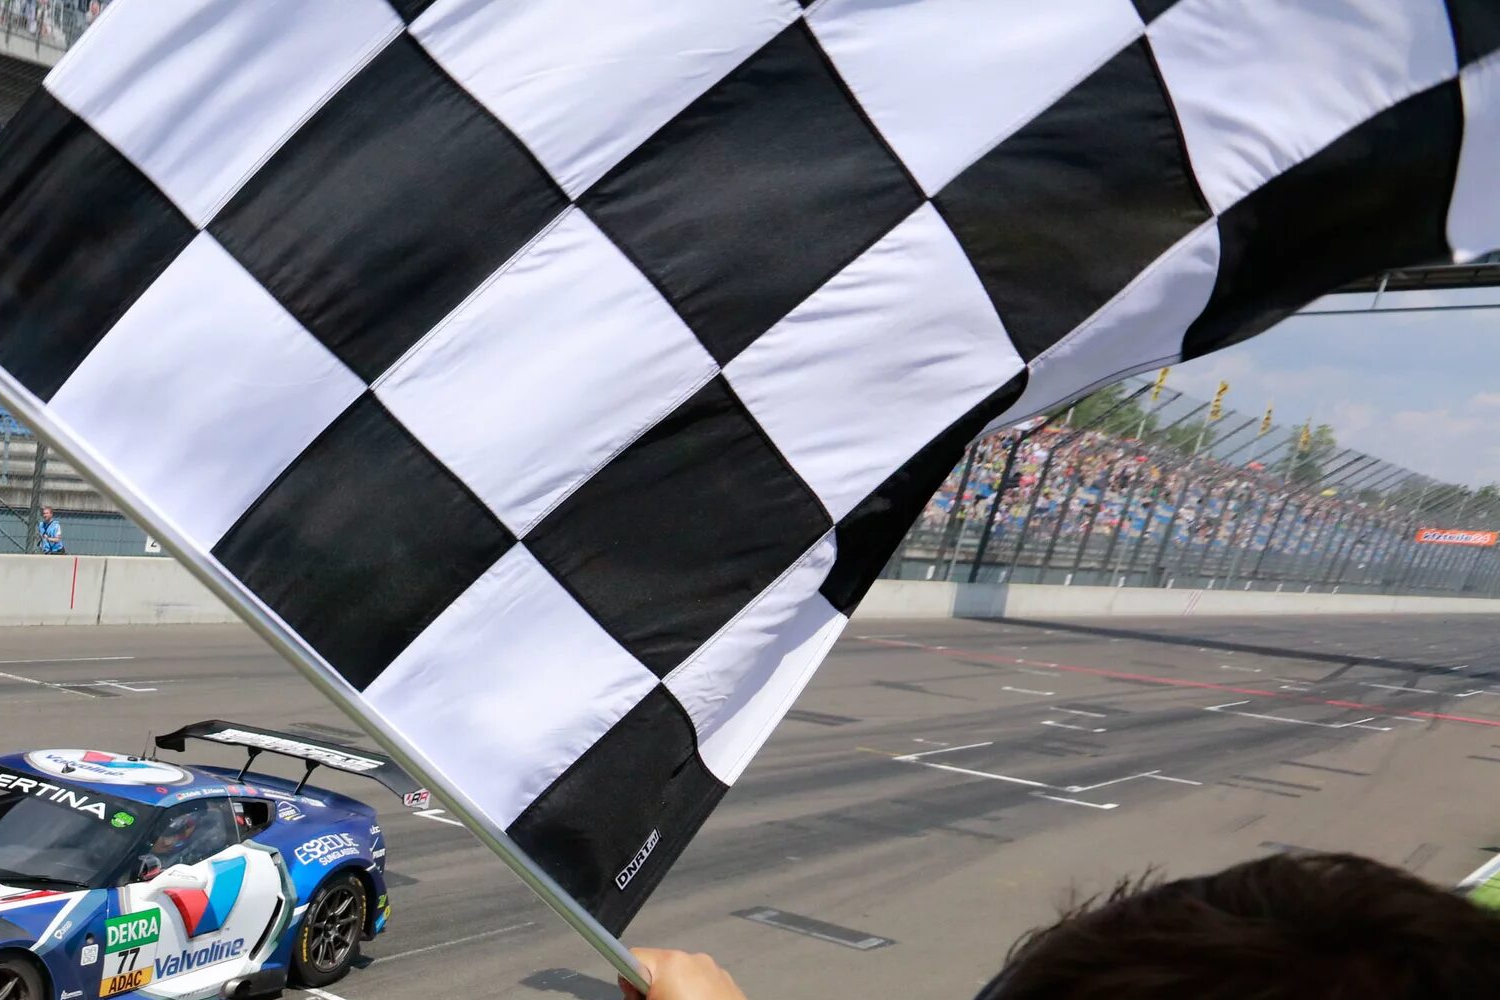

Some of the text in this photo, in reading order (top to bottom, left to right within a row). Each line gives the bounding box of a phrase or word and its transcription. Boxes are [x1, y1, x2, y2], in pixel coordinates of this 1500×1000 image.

[294, 833, 360, 865] ESSEDUE
[617, 832, 658, 886] DNRT.nl
[108, 916, 159, 947] DEKRA
[117, 947, 140, 975] 77
[155, 938, 245, 979] Valvoline
[108, 971, 143, 993] ADAC
